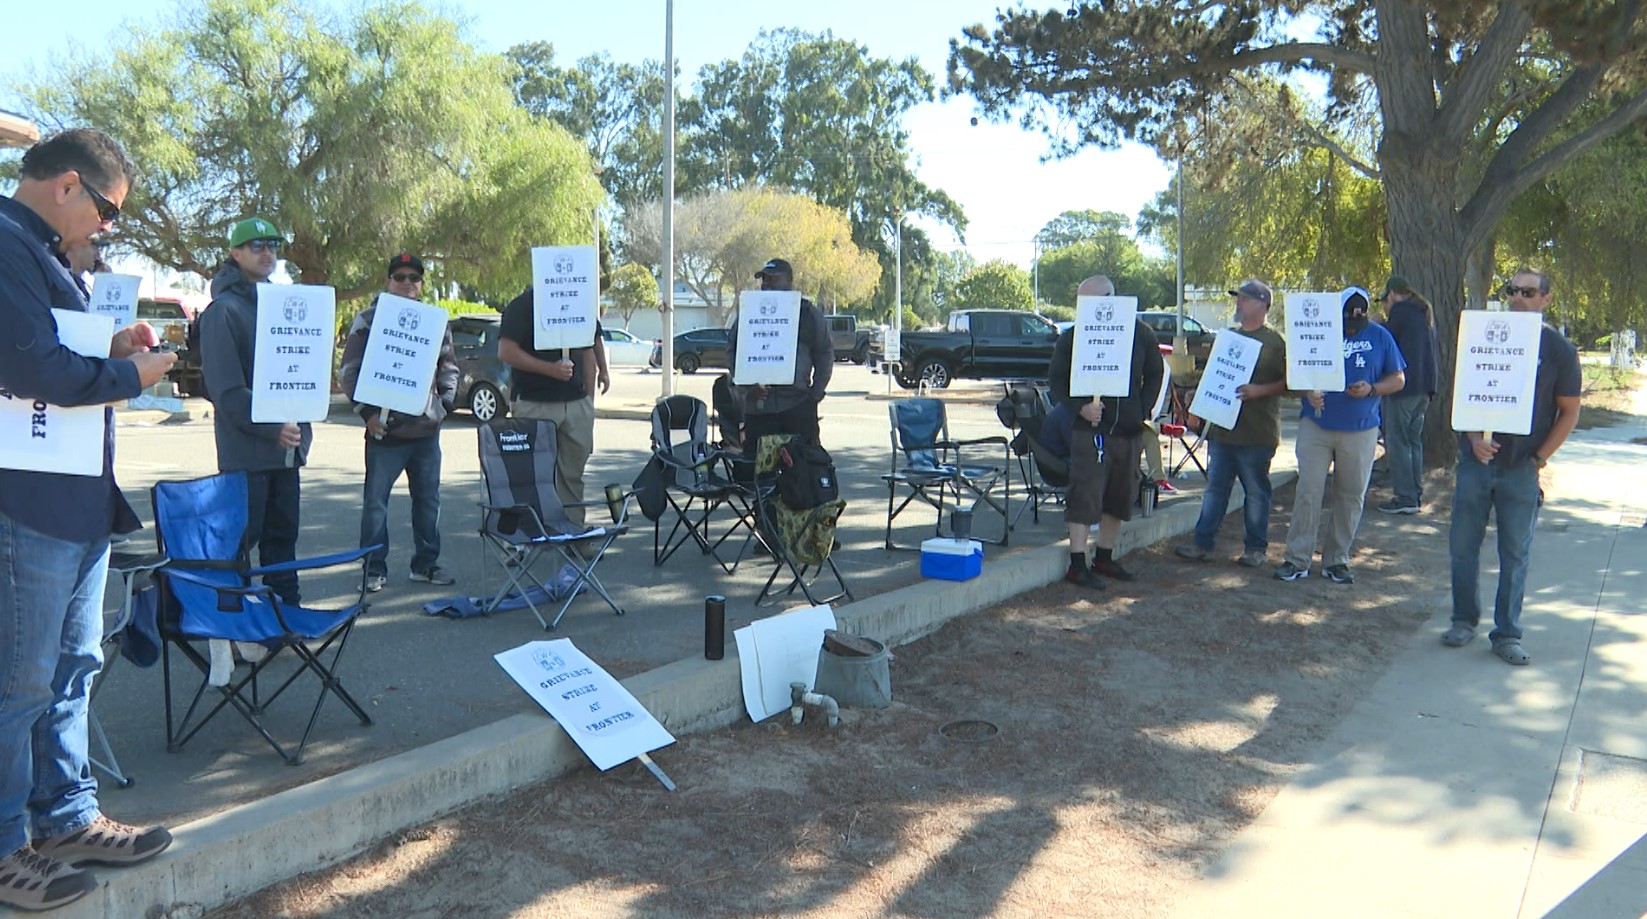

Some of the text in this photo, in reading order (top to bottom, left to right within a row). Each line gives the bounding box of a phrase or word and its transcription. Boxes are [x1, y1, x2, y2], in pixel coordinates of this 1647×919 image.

[545, 276, 588, 284] GRIEVANCE
[550, 290, 579, 298] STRIKE
[547, 316, 586, 325] FRONTIER
[270, 326, 322, 336] GRIEVANCE
[383, 328, 431, 346] GRIEVANCE
[276, 346, 310, 354] STRIKE
[385, 344, 417, 358] STRIKE
[1470, 346, 1525, 356] GRIEVANCE
[392, 361, 403, 369] AT
[1355, 353, 1366, 367] LA
[287, 365, 299, 373] AT
[1475, 363, 1512, 371] STRIKE
[373, 371, 418, 388] FRONTIER
[269, 382, 317, 390] FRONTIER
[1468, 394, 1518, 403] FRONTIER
[539, 666, 593, 690] GRIEVANCE
[561, 683, 598, 701] STRIKE
[589, 701, 602, 713] AT
[585, 710, 635, 732] FRONTIER
